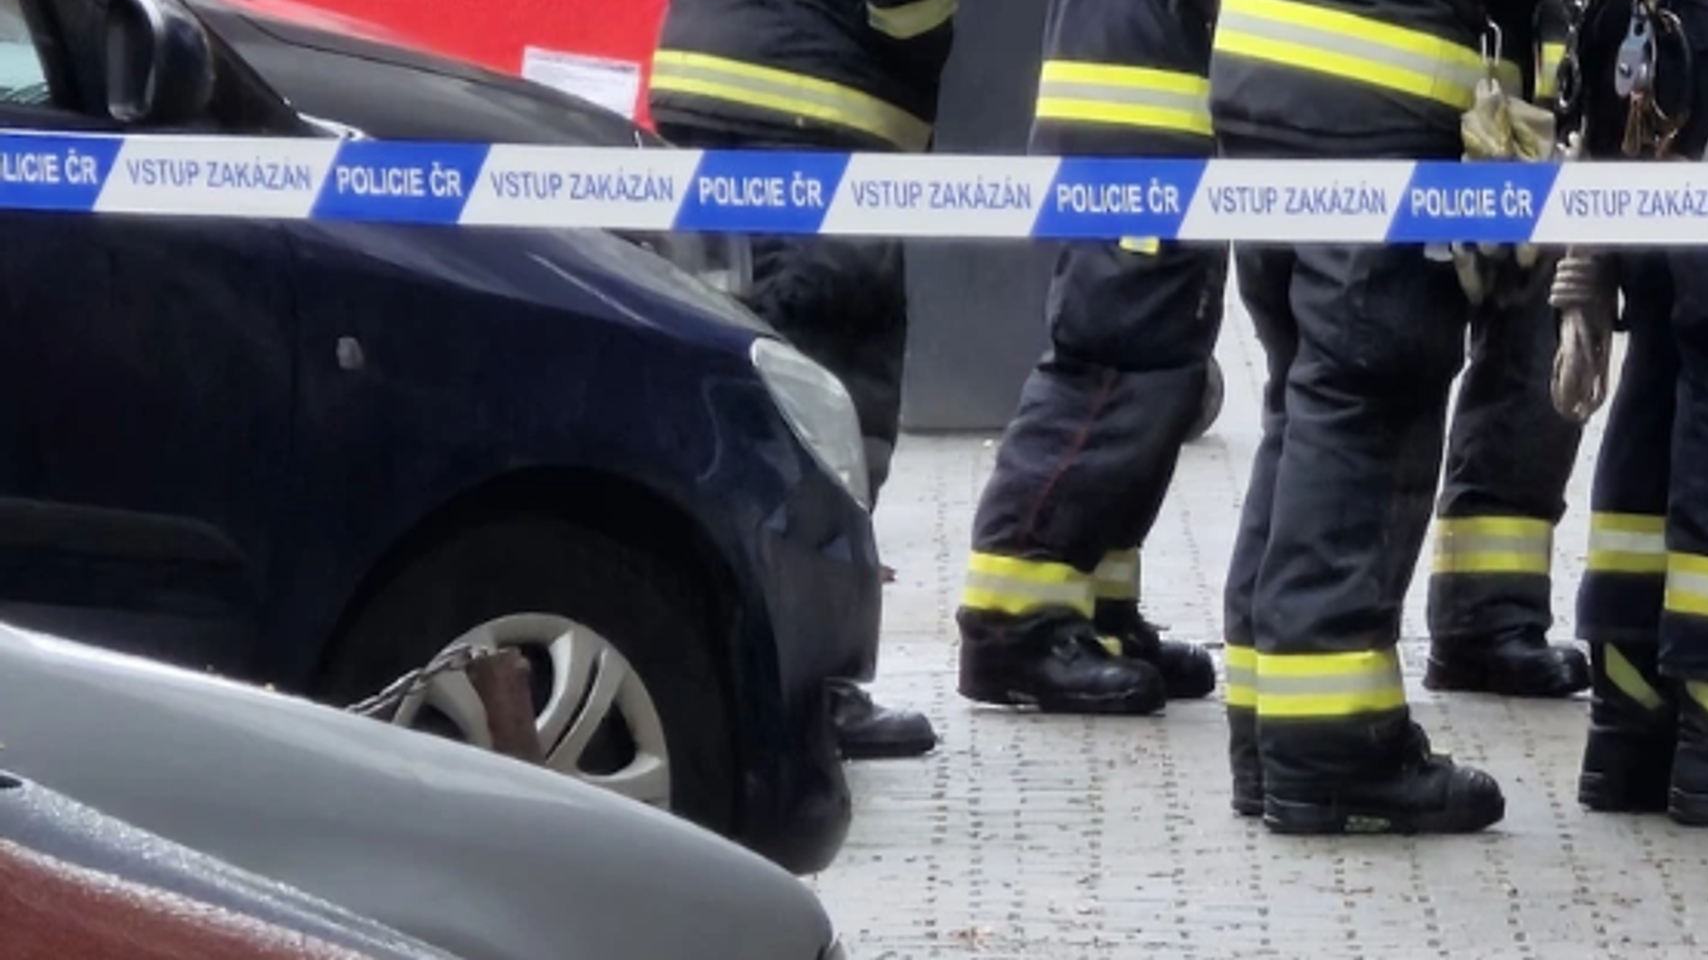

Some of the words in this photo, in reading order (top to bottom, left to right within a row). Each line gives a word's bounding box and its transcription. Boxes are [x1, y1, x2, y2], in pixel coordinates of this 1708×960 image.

[0, 152, 60, 182] LICIE
[65, 147, 97, 185] ČR
[127, 159, 199, 187] VSTUP
[206, 156, 312, 191] ZAKÁZÁN
[337, 166, 424, 196] POLICIE
[430, 161, 462, 198] ČR
[491, 173, 562, 198] VSTUP
[569, 169, 674, 202] ZAKÁZÁN
[700, 177, 786, 206] POLICIE
[792, 171, 823, 207] ČR
[852, 182, 922, 208] VSTUP
[929, 176, 1031, 209] ZAKÁZÁN
[1057, 183, 1142, 213] POLICIE
[1148, 178, 1179, 213] ČR
[1208, 186, 1278, 214] VSTUP
[1285, 181, 1387, 214] ZAKÁZÁN
[1411, 188, 1496, 217] POLICIE
[1501, 181, 1533, 217] ČR
[1562, 189, 1632, 217] VSTUP
